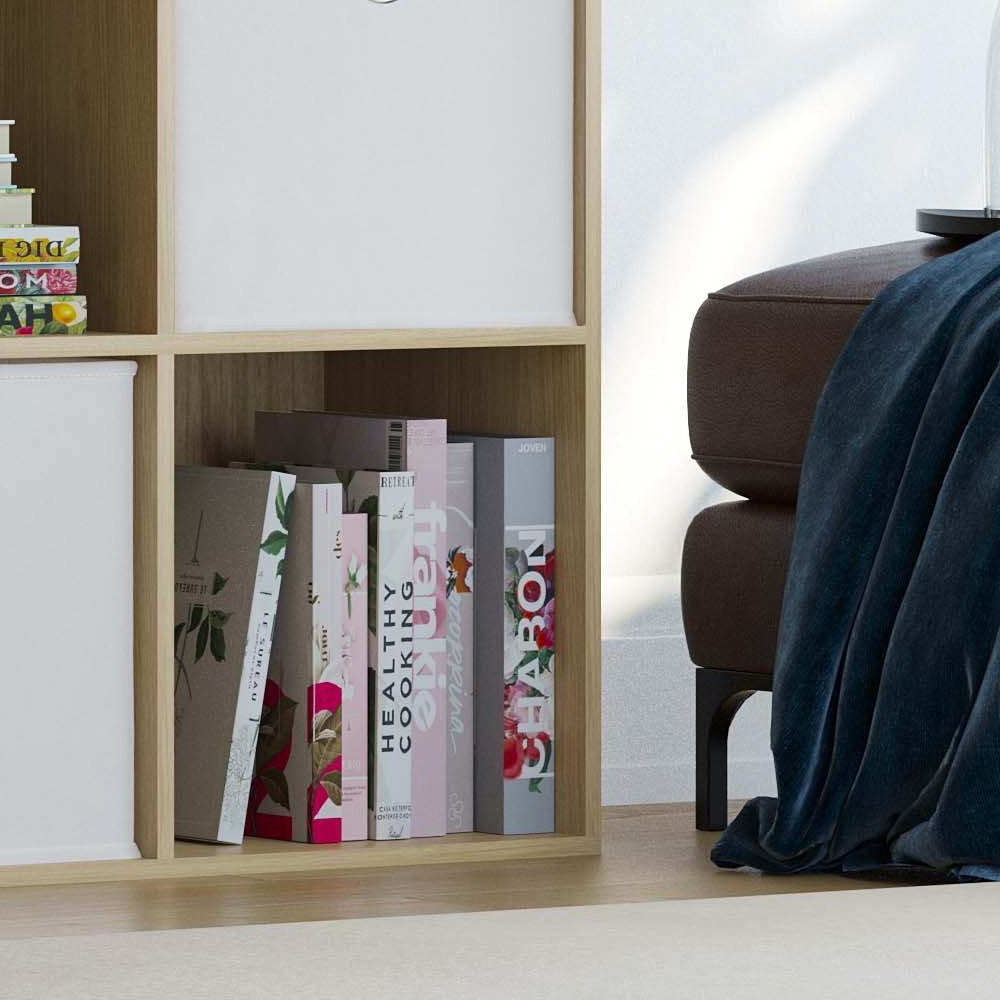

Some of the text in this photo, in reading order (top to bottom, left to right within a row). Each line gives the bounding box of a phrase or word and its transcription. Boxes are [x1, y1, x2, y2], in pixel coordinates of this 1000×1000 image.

[16, 240, 64, 258] DIG
[381, 583, 396, 753] HEALTHY
[399, 581, 414, 754] COOKING
[412, 502, 447, 732] frankie
